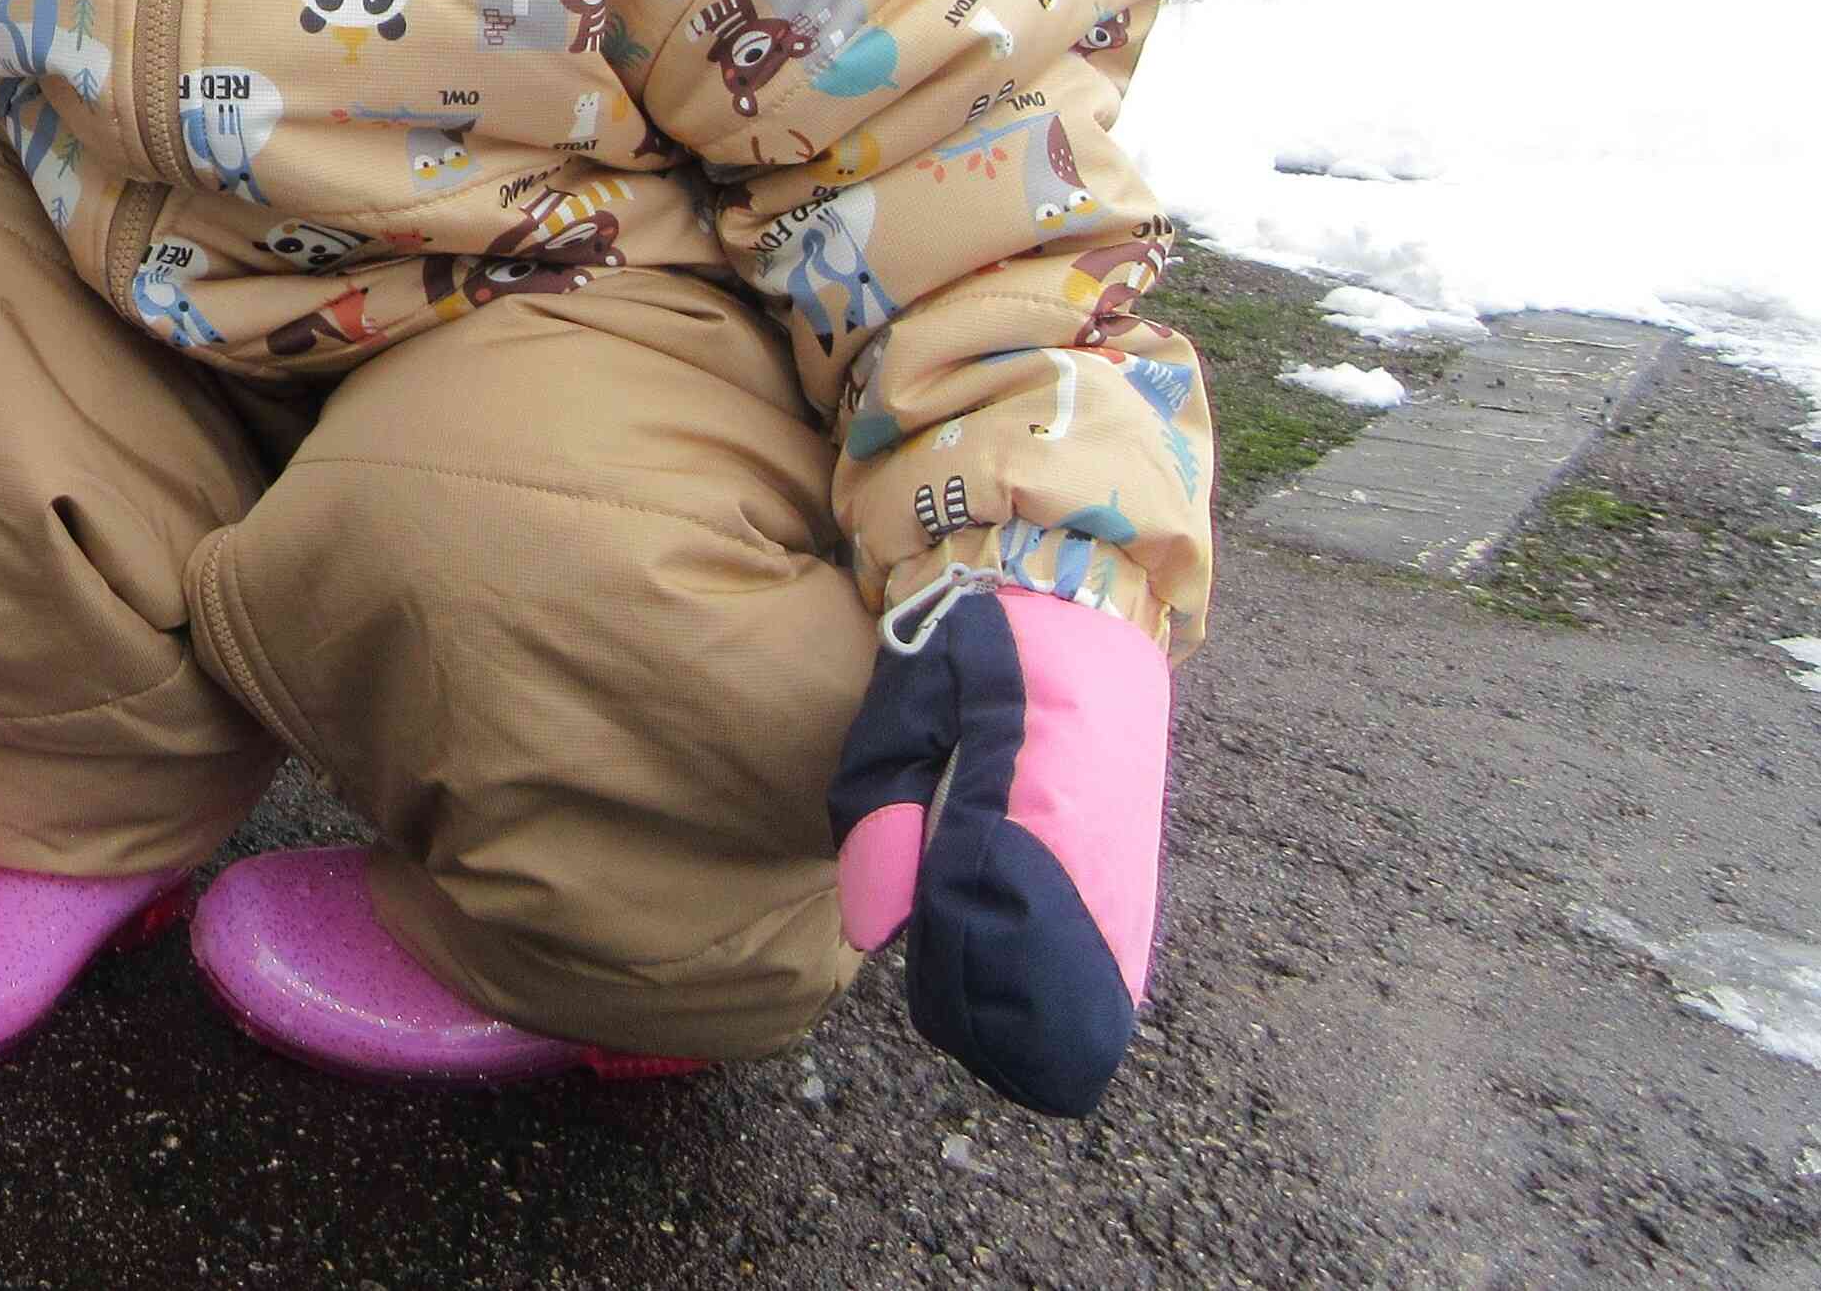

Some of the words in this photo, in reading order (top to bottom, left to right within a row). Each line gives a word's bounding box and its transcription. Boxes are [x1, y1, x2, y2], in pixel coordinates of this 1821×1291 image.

[200, 74, 251, 100] RED
[439, 89, 481, 106] OWL
[1006, 91, 1047, 112] OWL
[1143, 359, 1191, 413] SWAN
